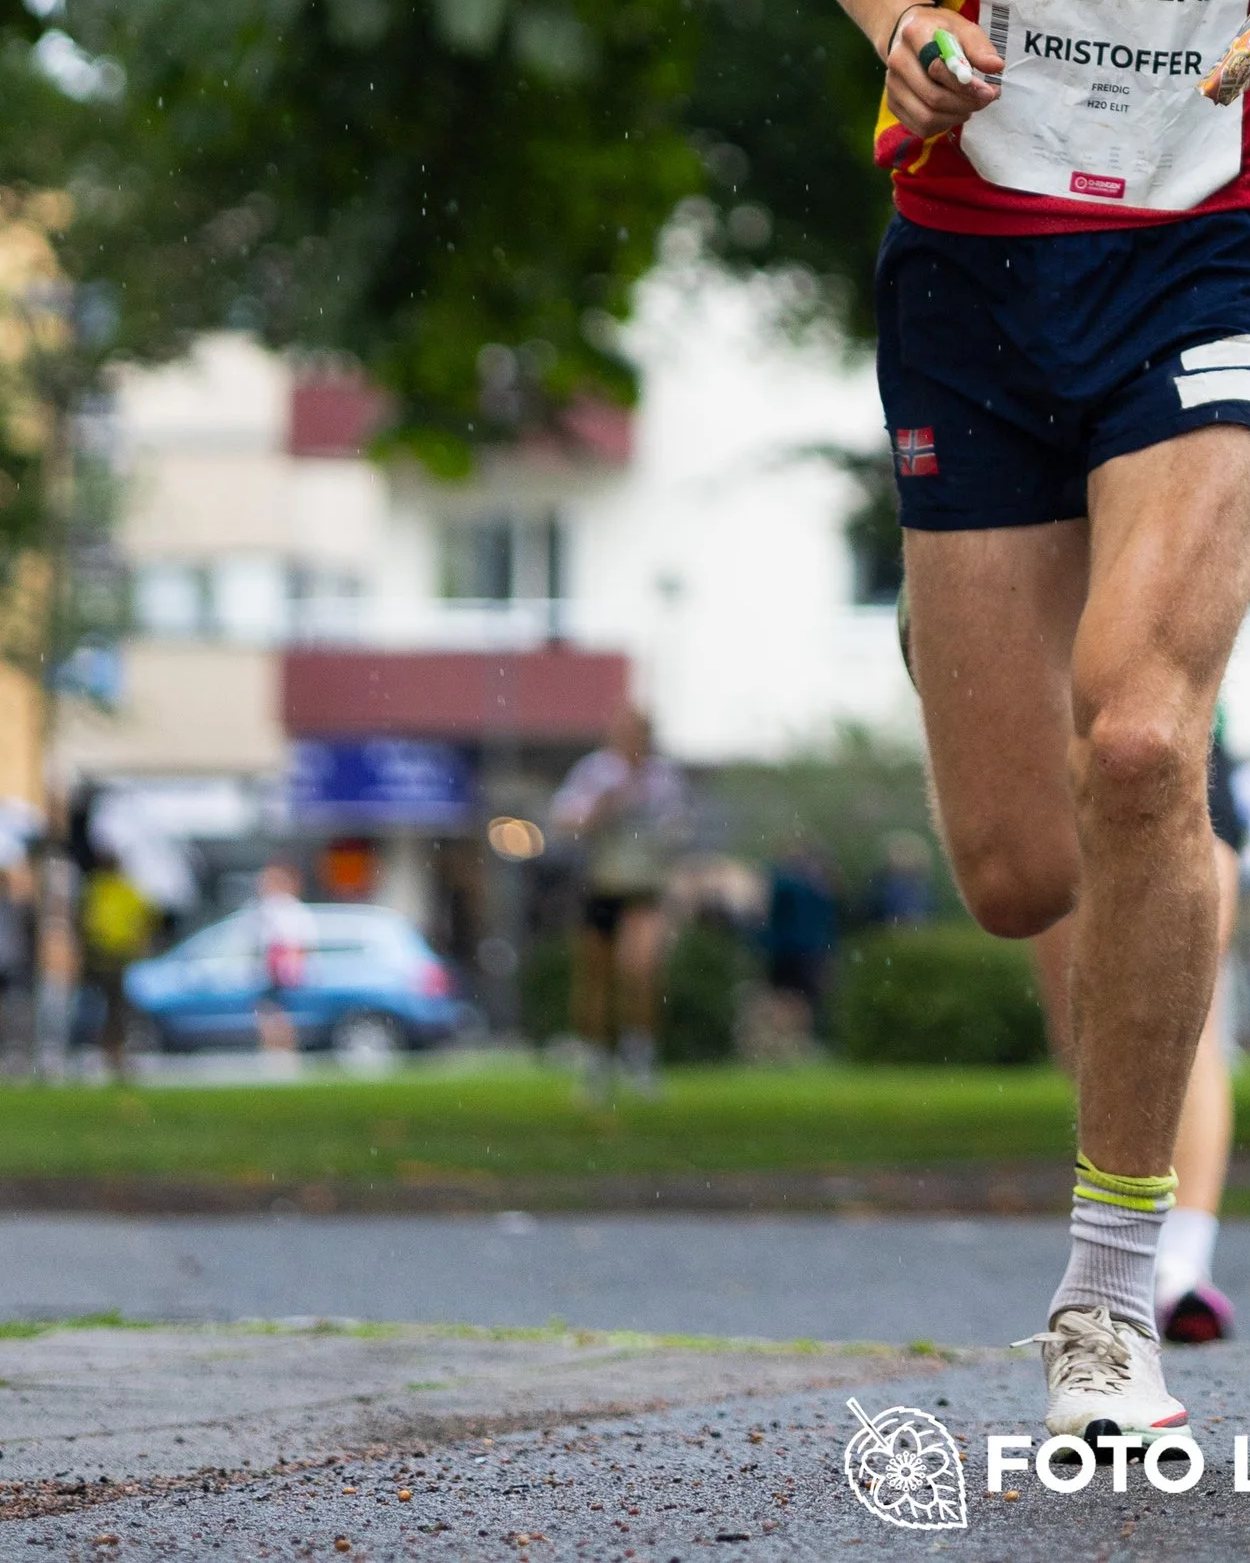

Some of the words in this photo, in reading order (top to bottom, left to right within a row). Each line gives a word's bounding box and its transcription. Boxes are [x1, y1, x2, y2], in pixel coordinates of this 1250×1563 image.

[1024, 30, 1202, 75] KRISTOFFER
[1091, 82, 1130, 95] FREIDIG
[1109, 102, 1130, 112] ELIT
